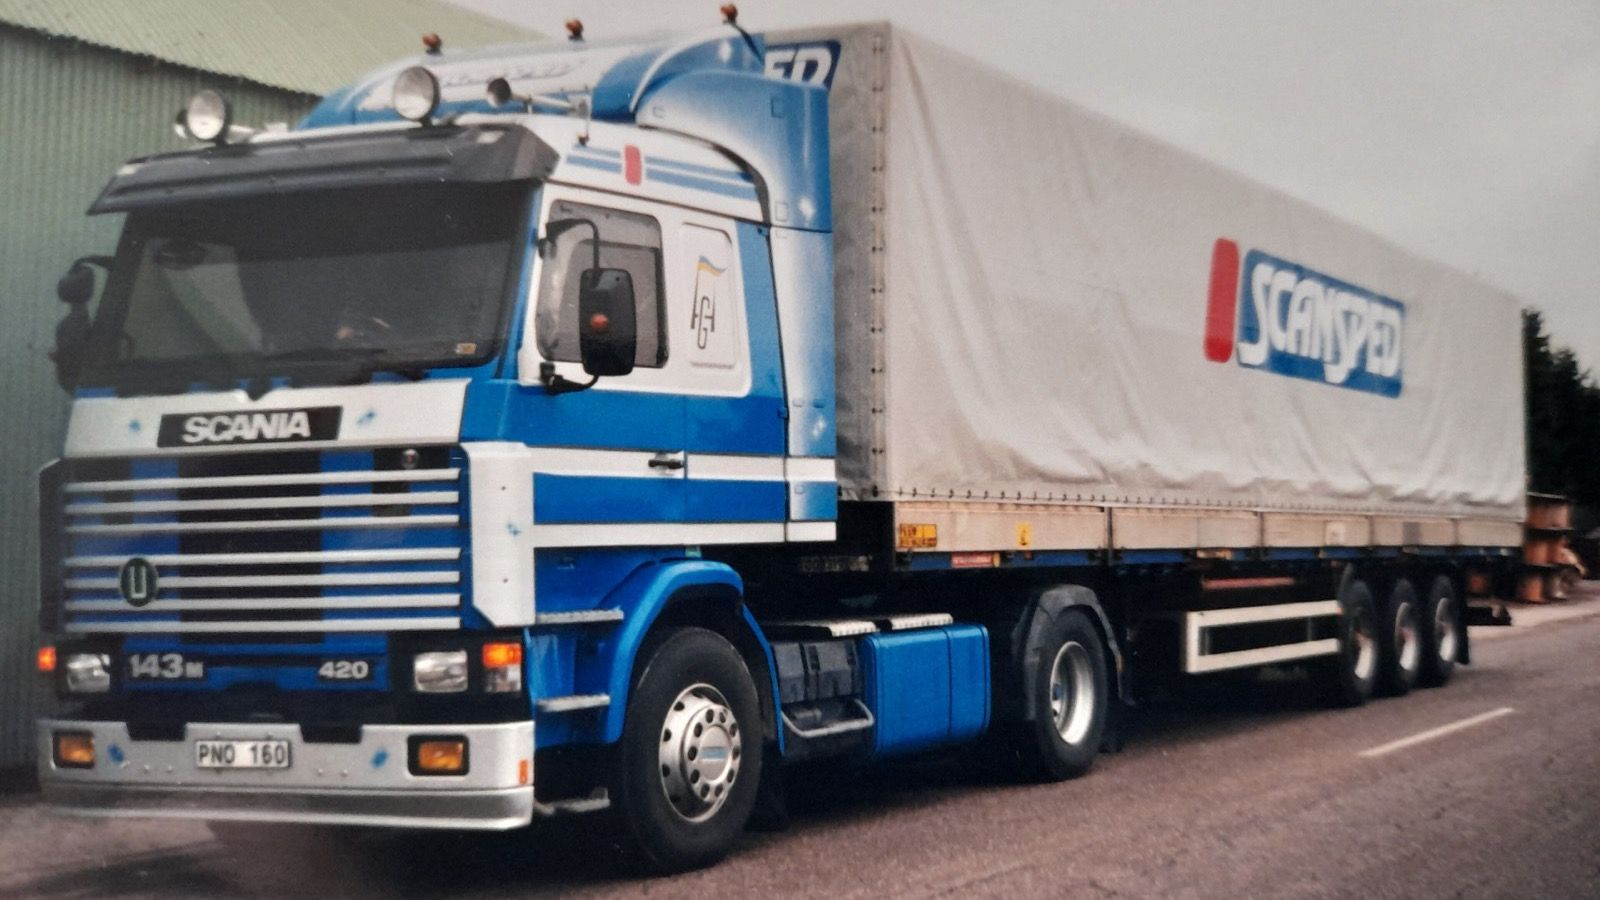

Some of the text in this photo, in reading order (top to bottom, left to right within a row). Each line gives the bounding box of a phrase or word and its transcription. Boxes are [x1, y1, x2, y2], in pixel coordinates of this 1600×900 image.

[1236, 262, 1402, 384] SCANSPED
[181, 411, 311, 443] SCANIA
[129, 565, 147, 599] U
[317, 660, 370, 679] 420
[198, 744, 287, 764] PNO 160
